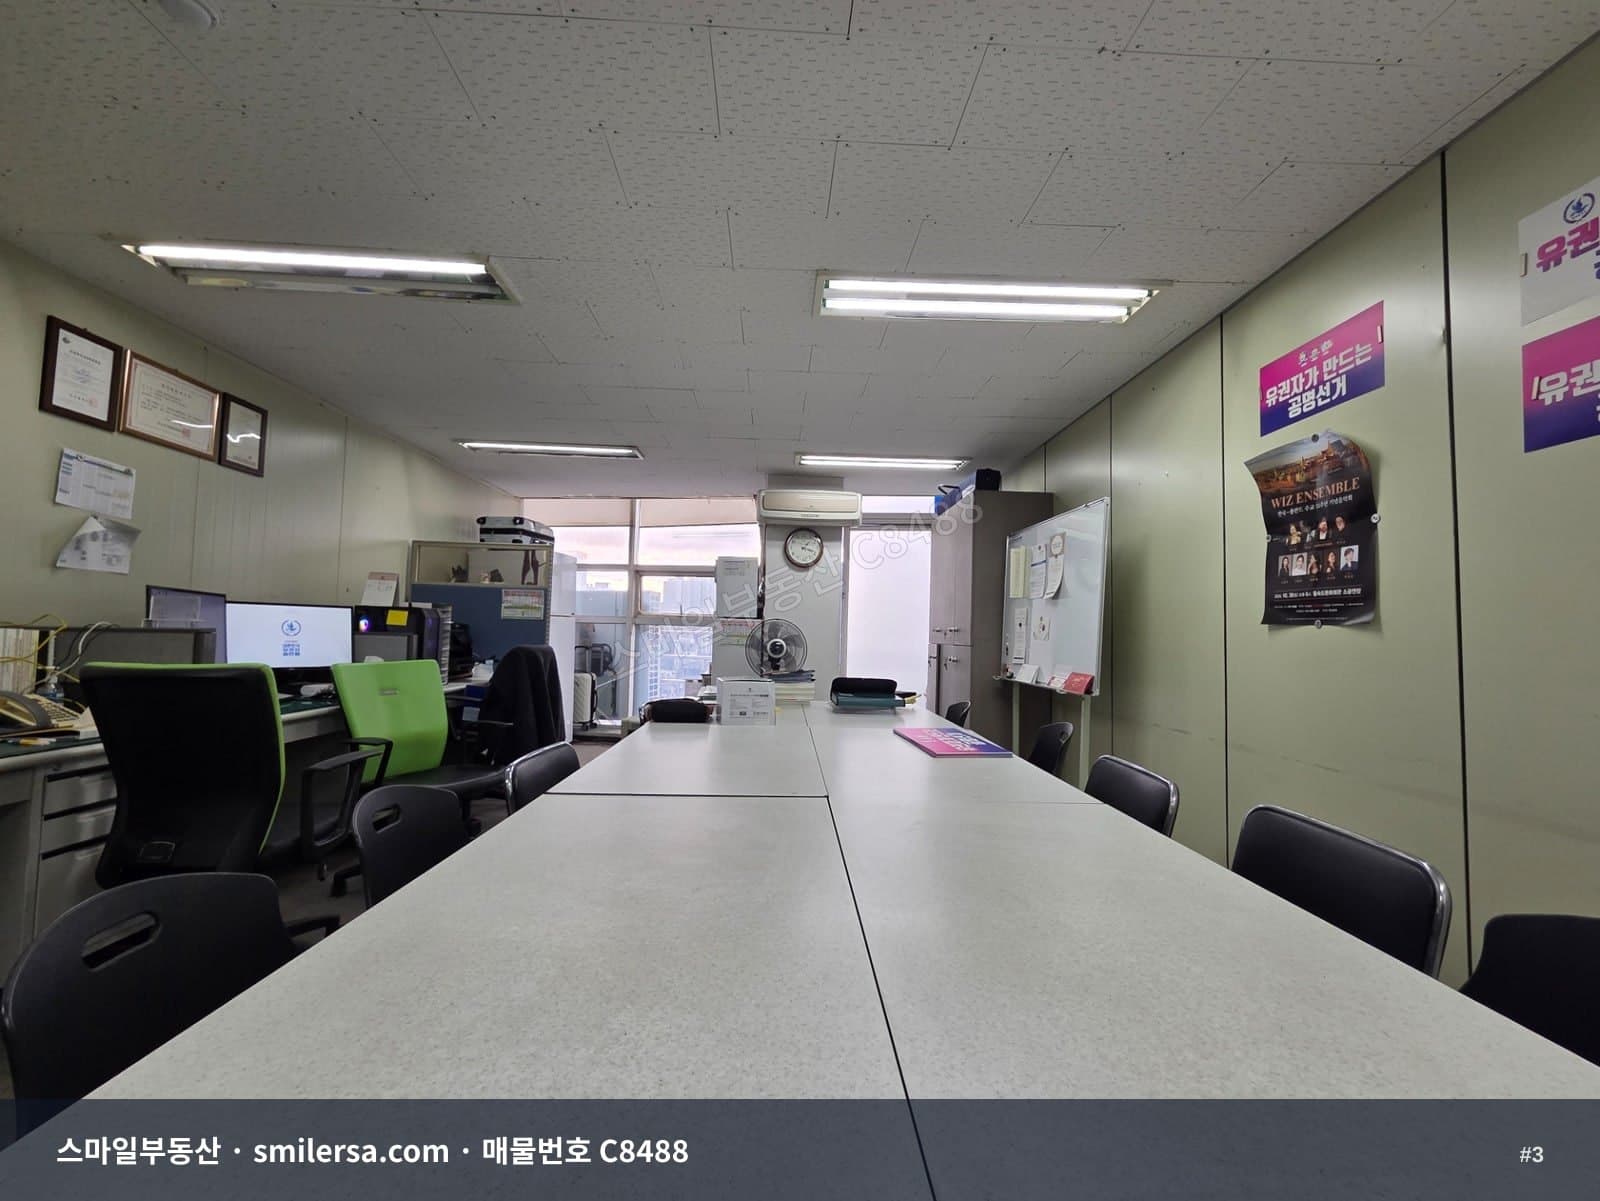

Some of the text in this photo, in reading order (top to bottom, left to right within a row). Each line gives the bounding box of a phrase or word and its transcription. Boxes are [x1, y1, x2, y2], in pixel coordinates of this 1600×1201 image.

[1266, 366, 1319, 408] 유권자가
[1323, 343, 1373, 381] 만드는
[1288, 374, 1347, 418] 공명선거
[1271, 477, 1360, 509] WIZ ENSEMBLE
